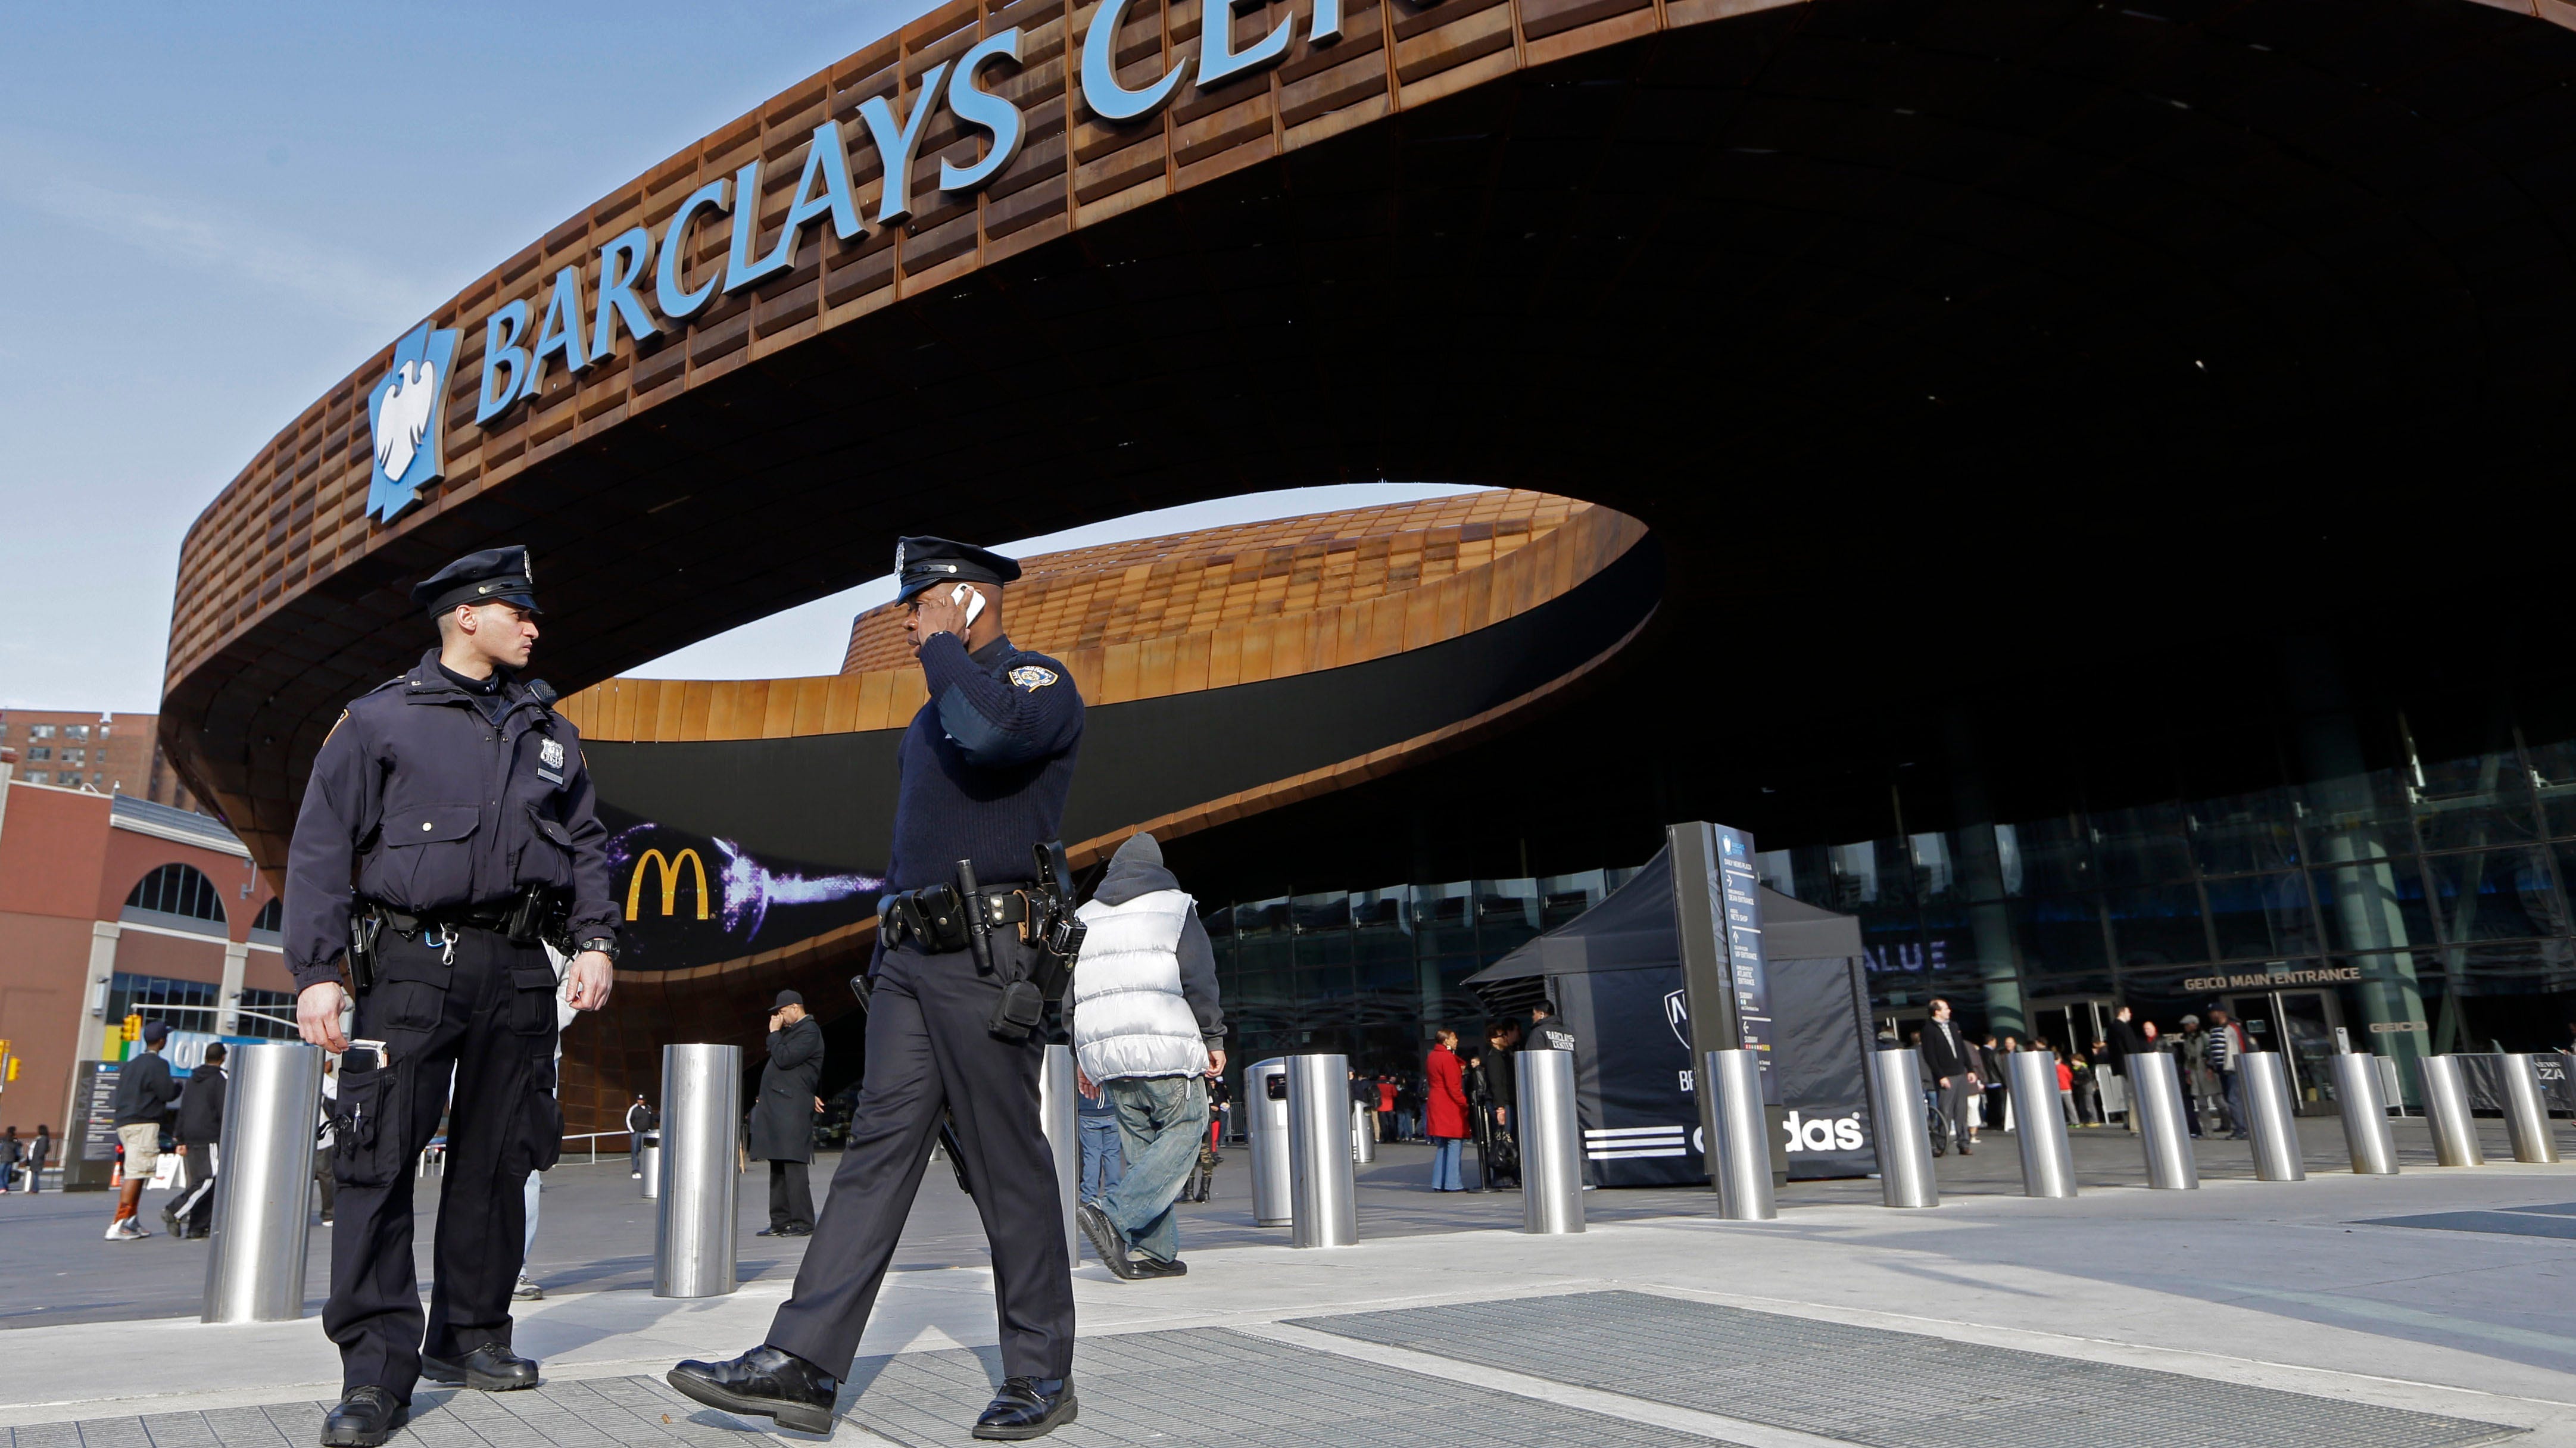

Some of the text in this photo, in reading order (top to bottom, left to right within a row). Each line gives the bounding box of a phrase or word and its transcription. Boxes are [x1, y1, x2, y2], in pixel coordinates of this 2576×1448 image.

[475, 0, 1344, 427] BARCLAYS CE
[2184, 967, 2361, 991] GEICO MAIN ENTRANCE
[2369, 1021, 2428, 1033] GEICO
[1546, 1031, 1575, 1043] BARCLAYS
[1552, 1040, 1574, 1051] CENTER
